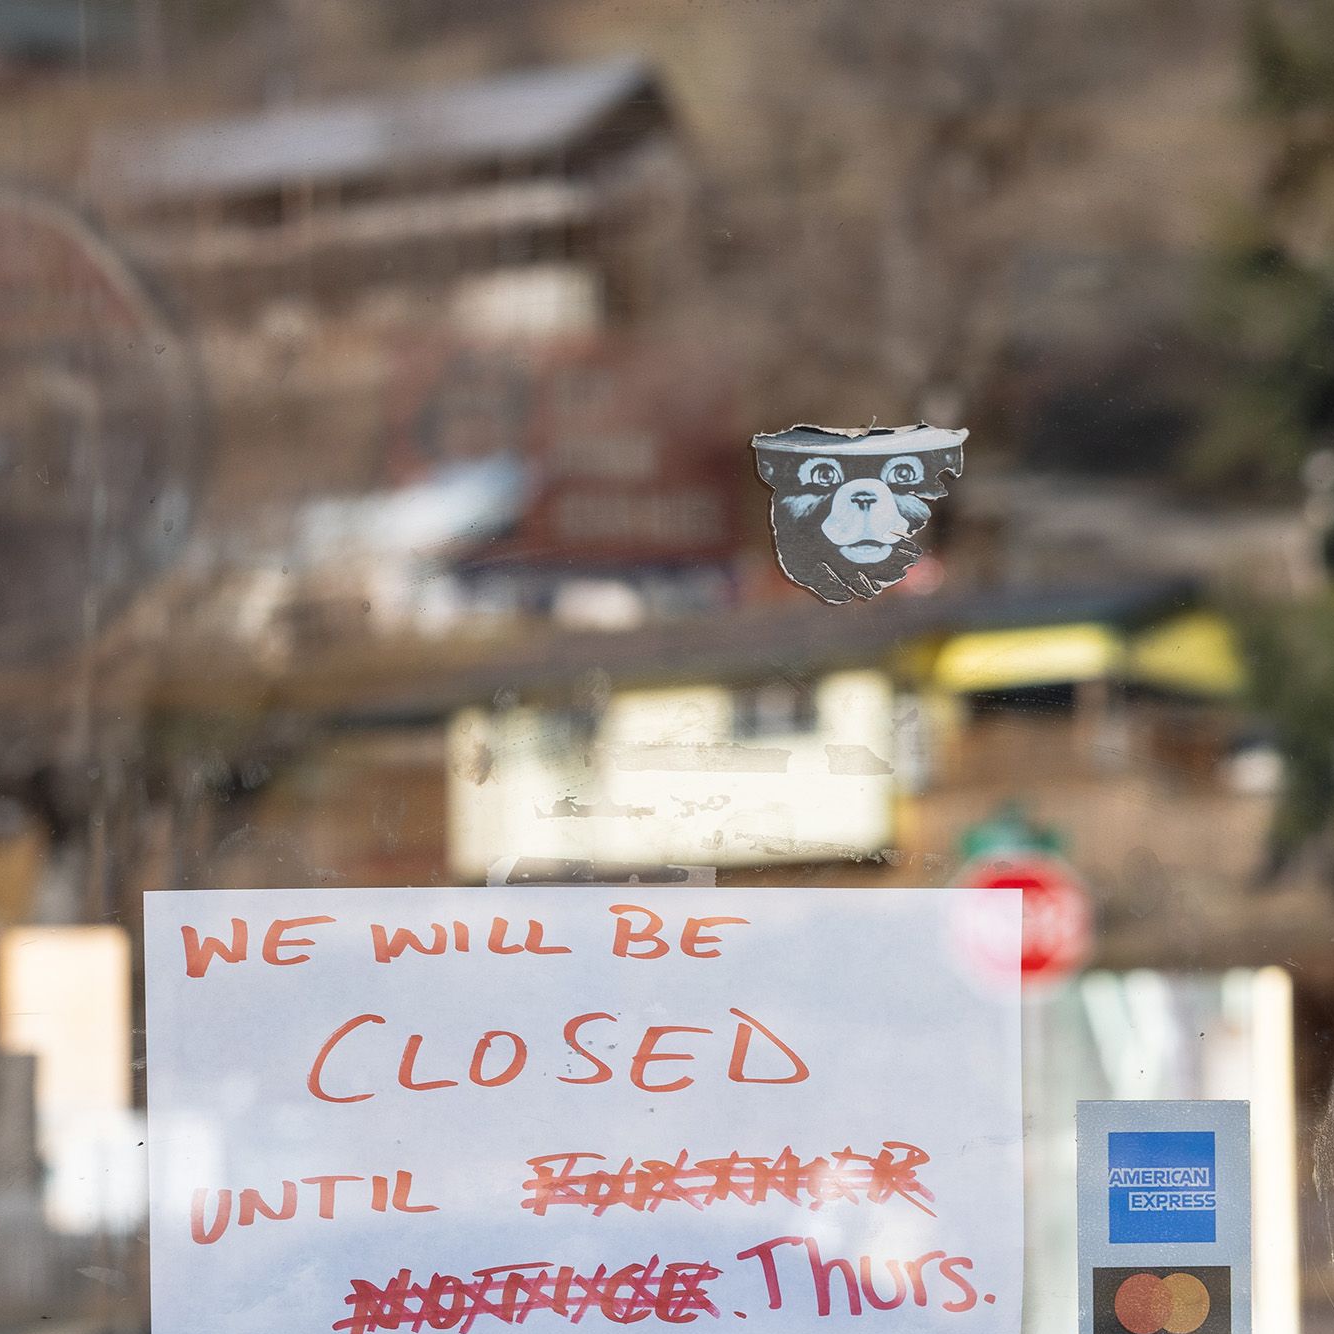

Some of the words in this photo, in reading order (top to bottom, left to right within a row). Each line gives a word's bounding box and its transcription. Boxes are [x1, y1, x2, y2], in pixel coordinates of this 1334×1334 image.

[181, 915, 337, 979] WE
[370, 916, 572, 964] WILL
[609, 903, 750, 961] BE
[307, 1007, 810, 1104] CLOSED
[190, 1169, 440, 1245] UNTIL
[1108, 1167, 1209, 1187] AMERICAN
[1130, 1192, 1216, 1211] EXPRESS
[736, 1235, 998, 1320] Thurs.
